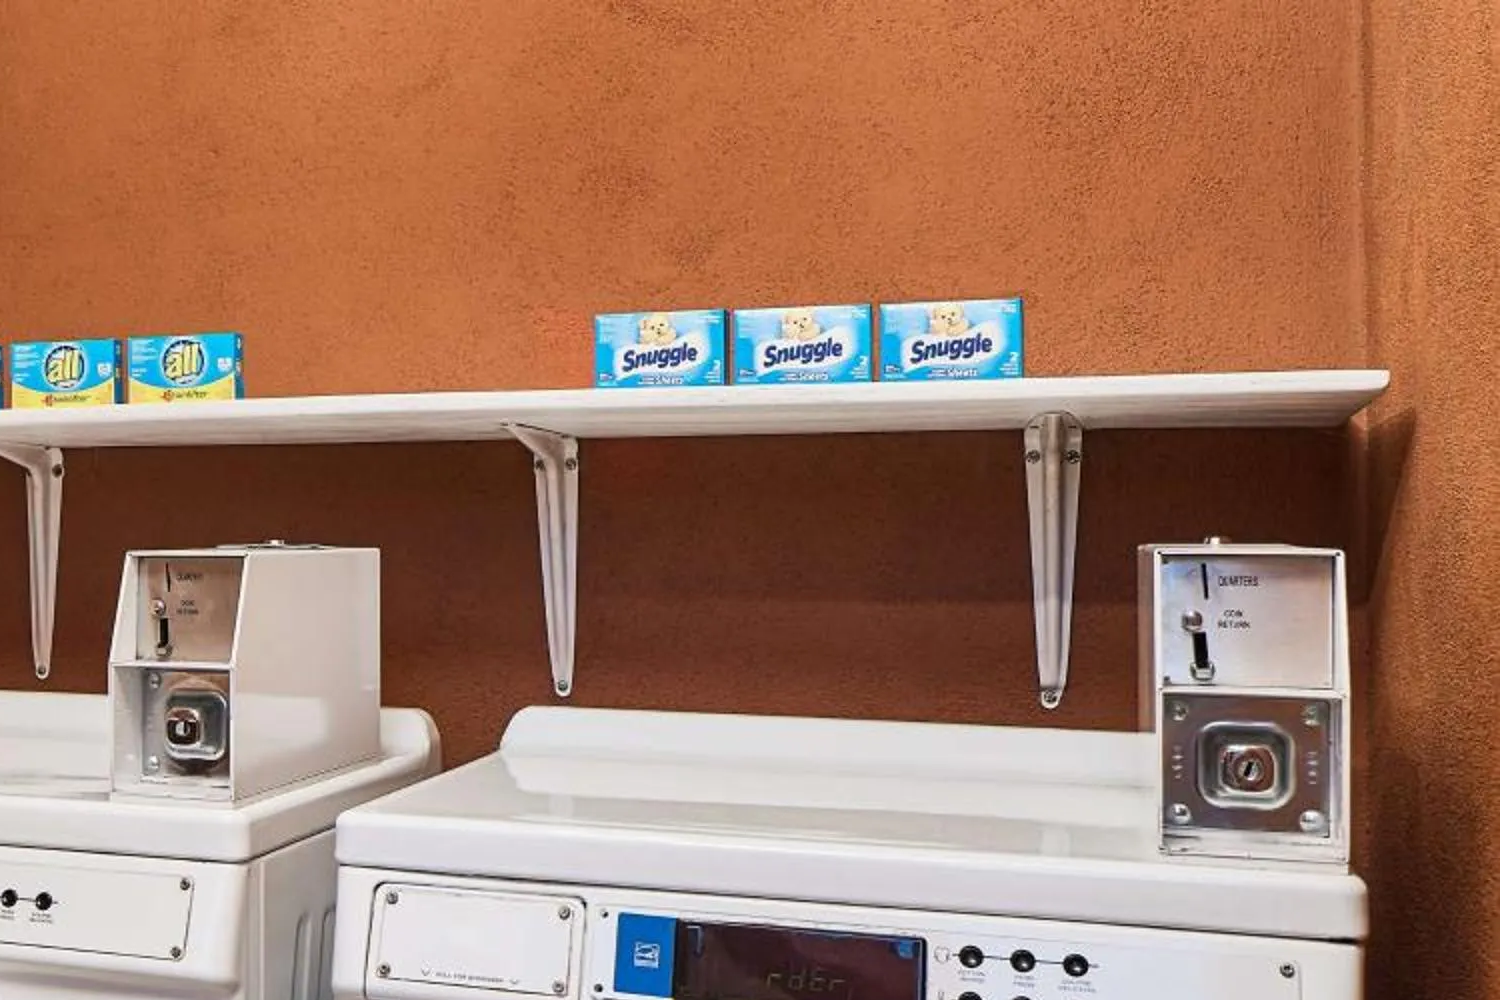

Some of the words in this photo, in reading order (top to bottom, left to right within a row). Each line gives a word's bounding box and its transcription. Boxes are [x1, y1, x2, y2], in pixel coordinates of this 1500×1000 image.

[165, 343, 200, 380] all
[621, 342, 699, 372] Snuggle
[763, 337, 843, 368] Snuggle
[909, 332, 993, 365] Snuggle
[47, 348, 80, 383] all
[1218, 576, 1259, 587] QUARTERS
